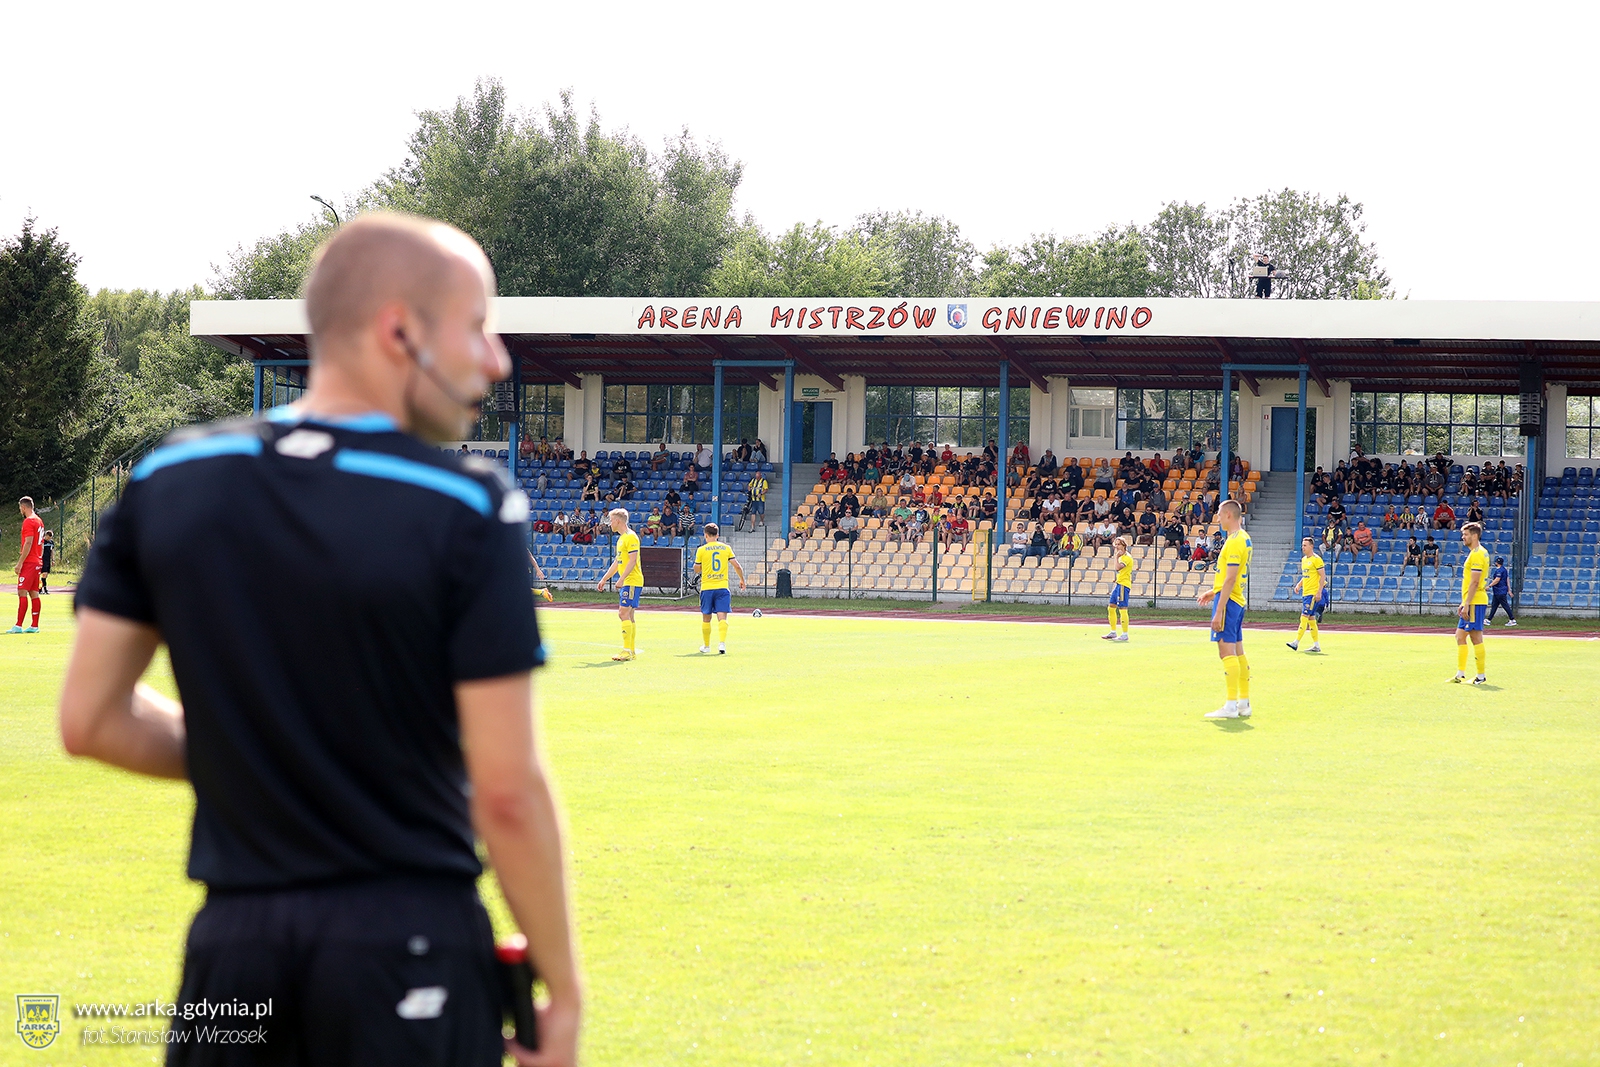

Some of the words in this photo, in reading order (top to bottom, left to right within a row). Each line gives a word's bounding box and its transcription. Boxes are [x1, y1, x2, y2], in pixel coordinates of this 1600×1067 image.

[637, 304, 742, 330] ARENA
[770, 302, 937, 330] MISTRZÓW
[982, 304, 1153, 333] GNIEWINO
[712, 551, 721, 572] 6
